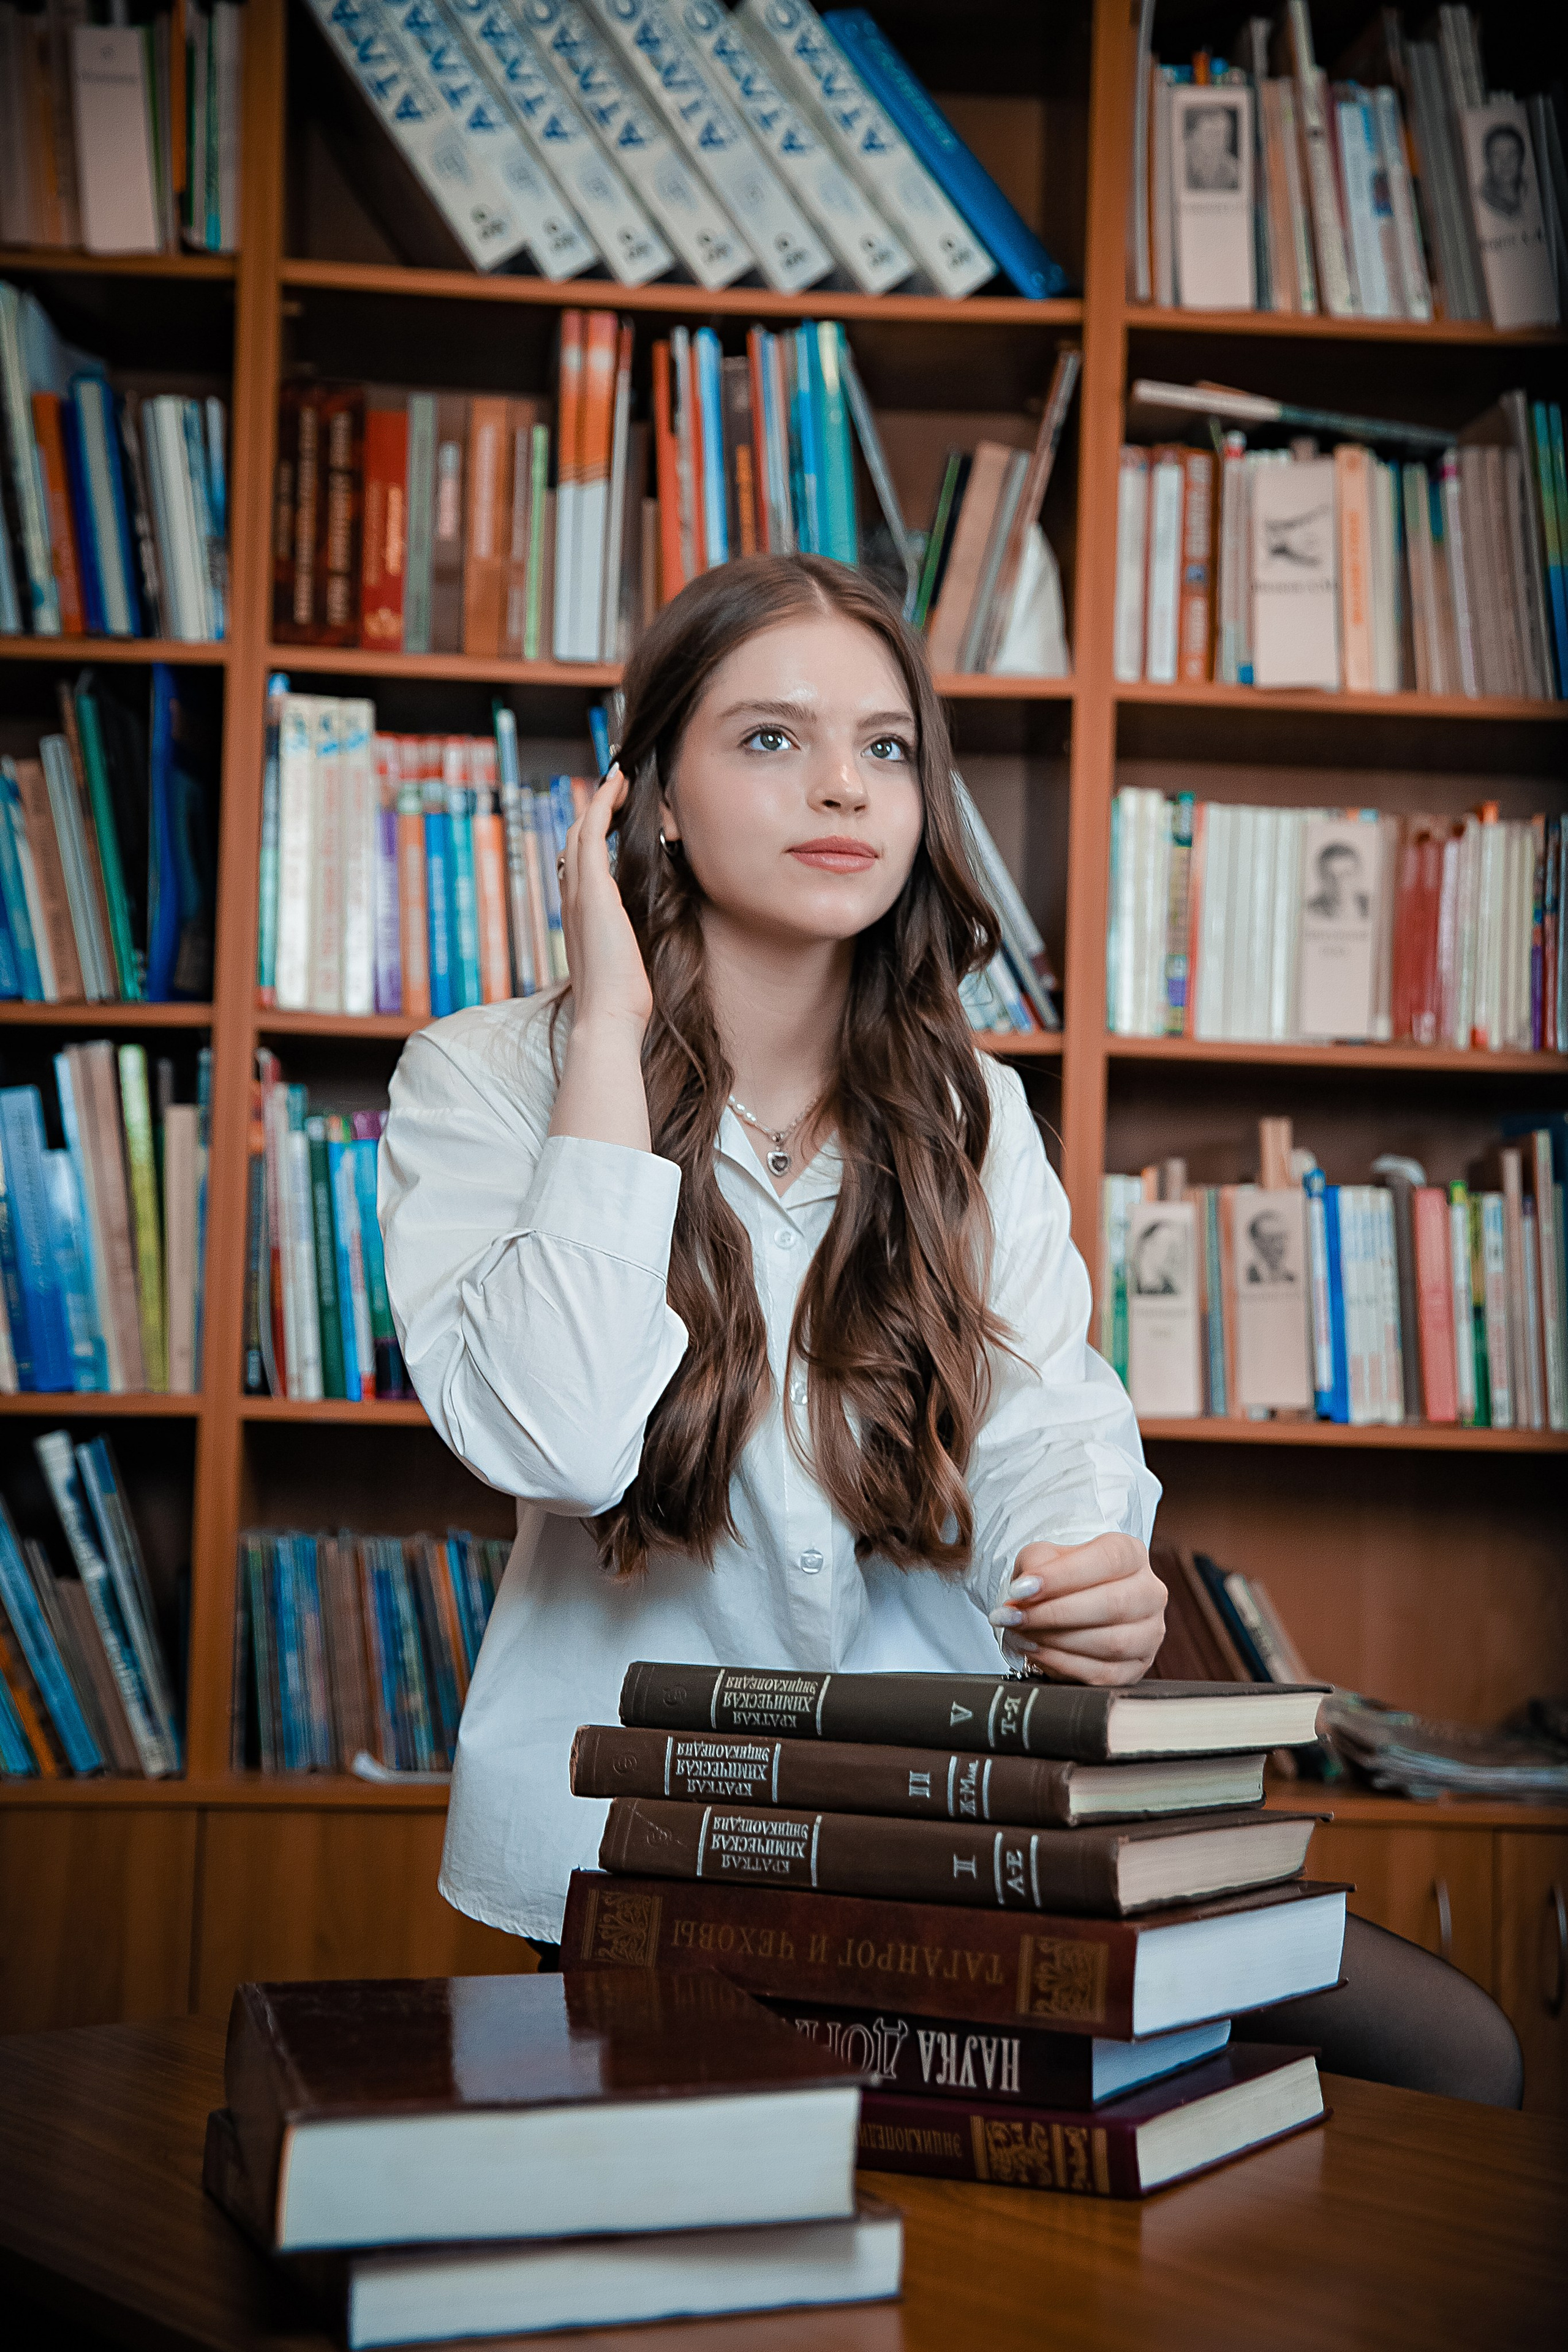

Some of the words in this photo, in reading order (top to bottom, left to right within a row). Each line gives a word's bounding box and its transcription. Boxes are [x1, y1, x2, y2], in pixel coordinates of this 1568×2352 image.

[725, 1676, 818, 1694] ЭНЦИКЛОПЕДИЯ
[723, 1691, 815, 1713] ХИМИЧЕСКАЯ
[733, 1711, 797, 1728] КРАТКАЯ
[950, 1702, 973, 1727] V
[1001, 1696, 1021, 1736] Т-Я
[677, 1741, 770, 1762] ЭНЦИКЛОПЕДИЯ
[676, 1758, 767, 1781] ХИМИЧЕСКАЯ
[687, 1779, 753, 1796] КРАТКАЯ
[909, 1771, 930, 1798] II
[714, 1816, 809, 1839] ЭНЦИКЛОПЕДИЯ
[712, 1834, 806, 1858] ХИМИЧЕСКАЯ
[722, 1854, 790, 1874] КРАТКАЯ
[672, 1920, 795, 1959] ЧЕХОВЫ
[809, 1933, 829, 1964] И
[839, 1937, 1005, 1985] ТАГАНРОГ
[917, 2030, 1020, 2092] НАУКА
